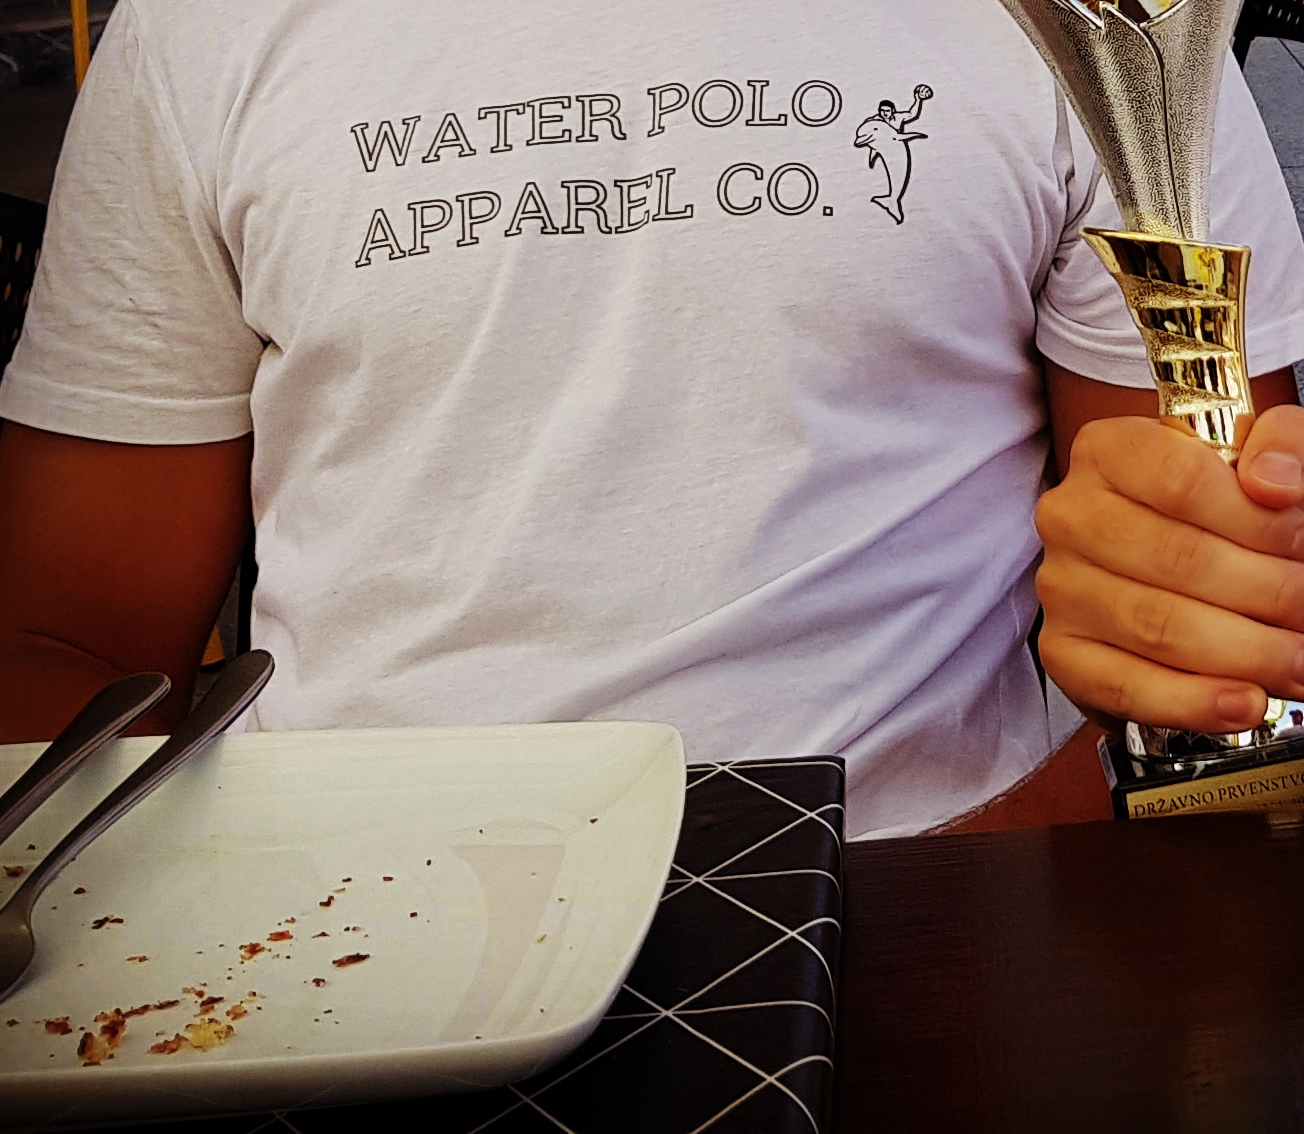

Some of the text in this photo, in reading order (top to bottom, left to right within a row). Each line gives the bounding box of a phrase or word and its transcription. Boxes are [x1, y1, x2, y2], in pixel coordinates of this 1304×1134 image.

[350, 79, 843, 173] WATER POLO
[355, 162, 834, 268] APPAREL CO.
[1133, 790, 1214, 817] DRŽAVNO
